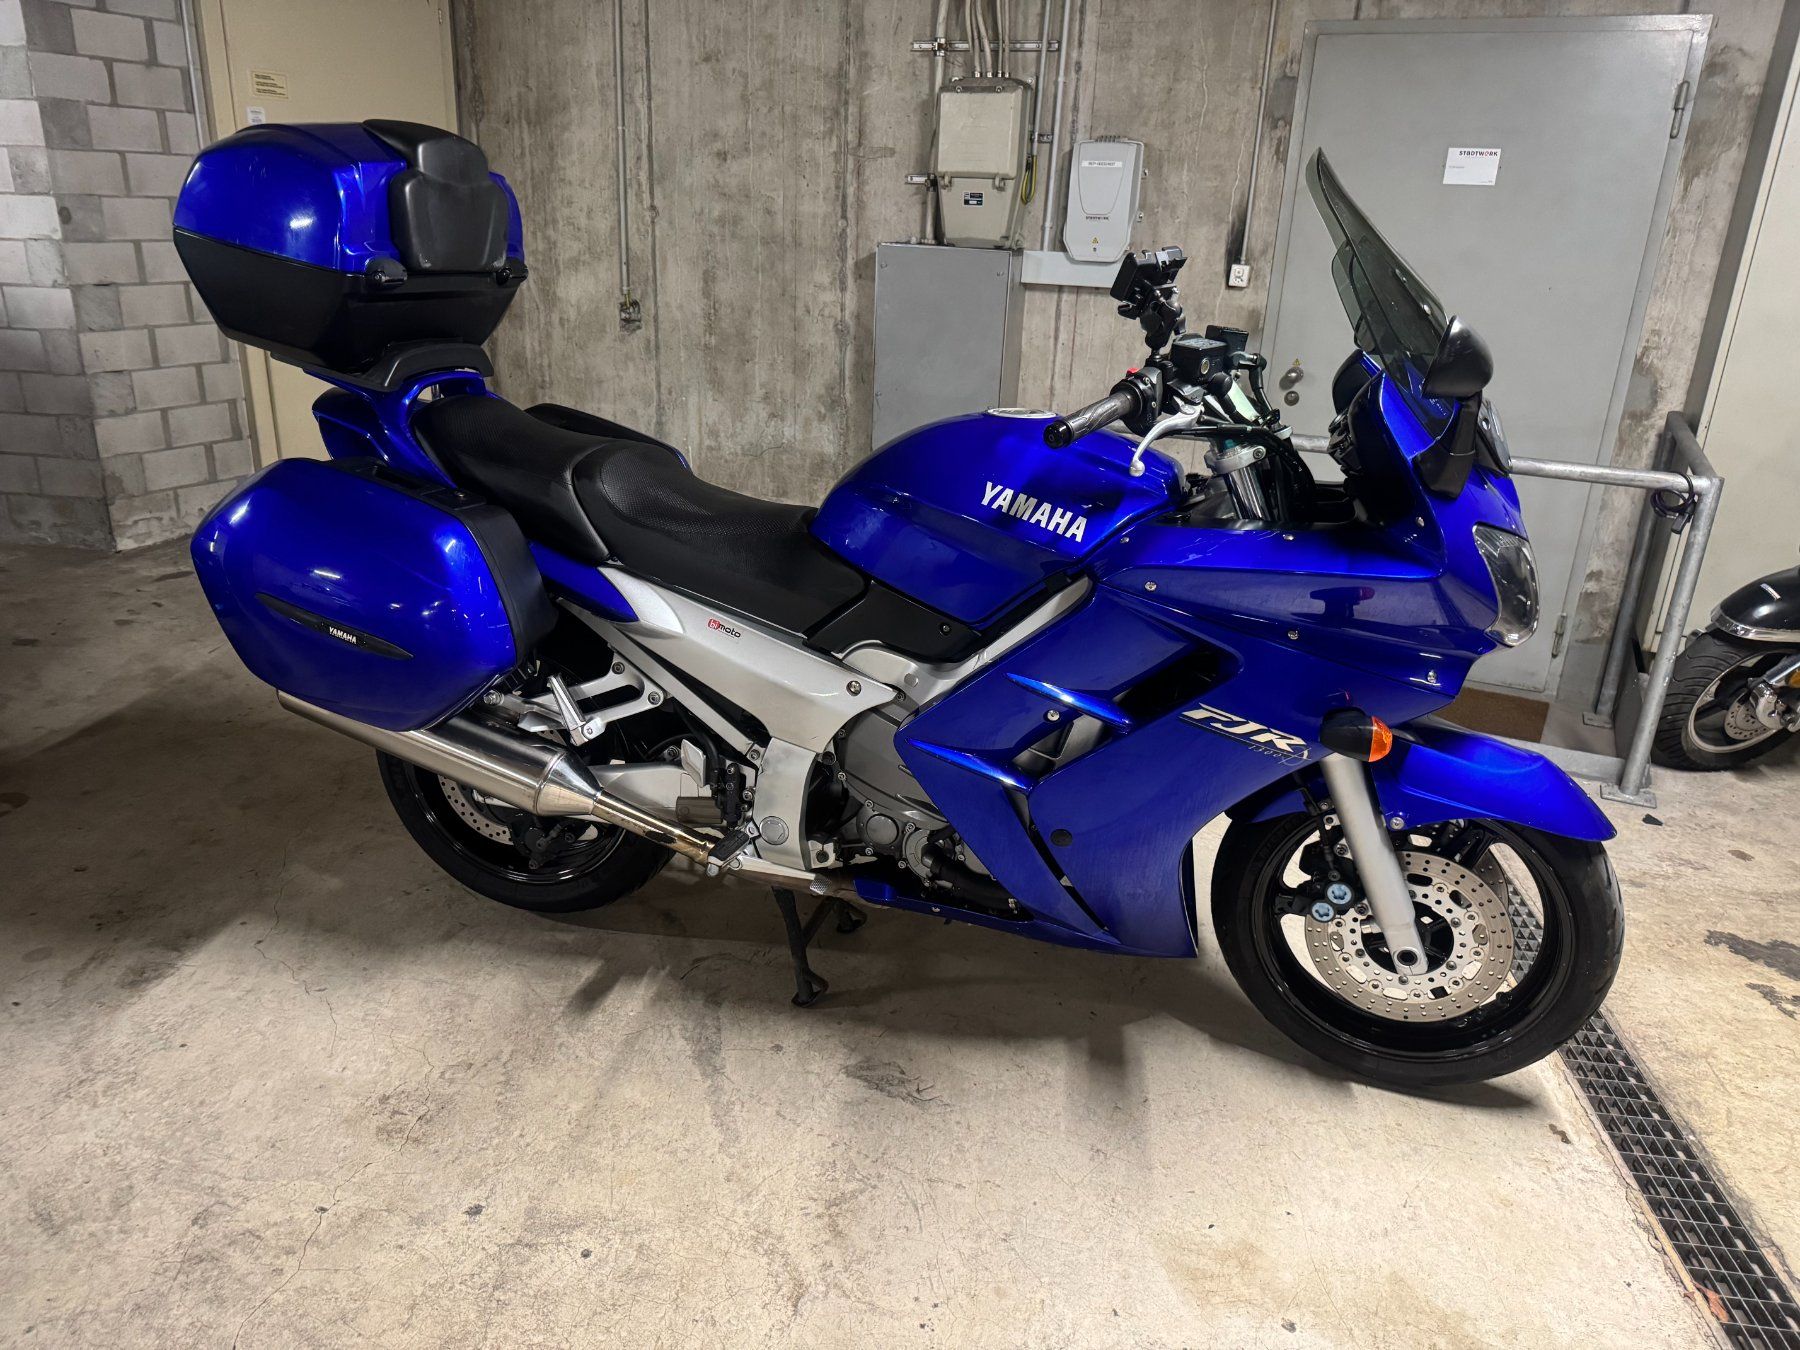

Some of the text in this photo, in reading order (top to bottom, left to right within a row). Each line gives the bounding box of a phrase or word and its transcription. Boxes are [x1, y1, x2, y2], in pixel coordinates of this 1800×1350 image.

[981, 481, 1088, 543] YAMAHA
[329, 626, 357, 645] YAMAHA
[1181, 702, 1307, 753] FJR
